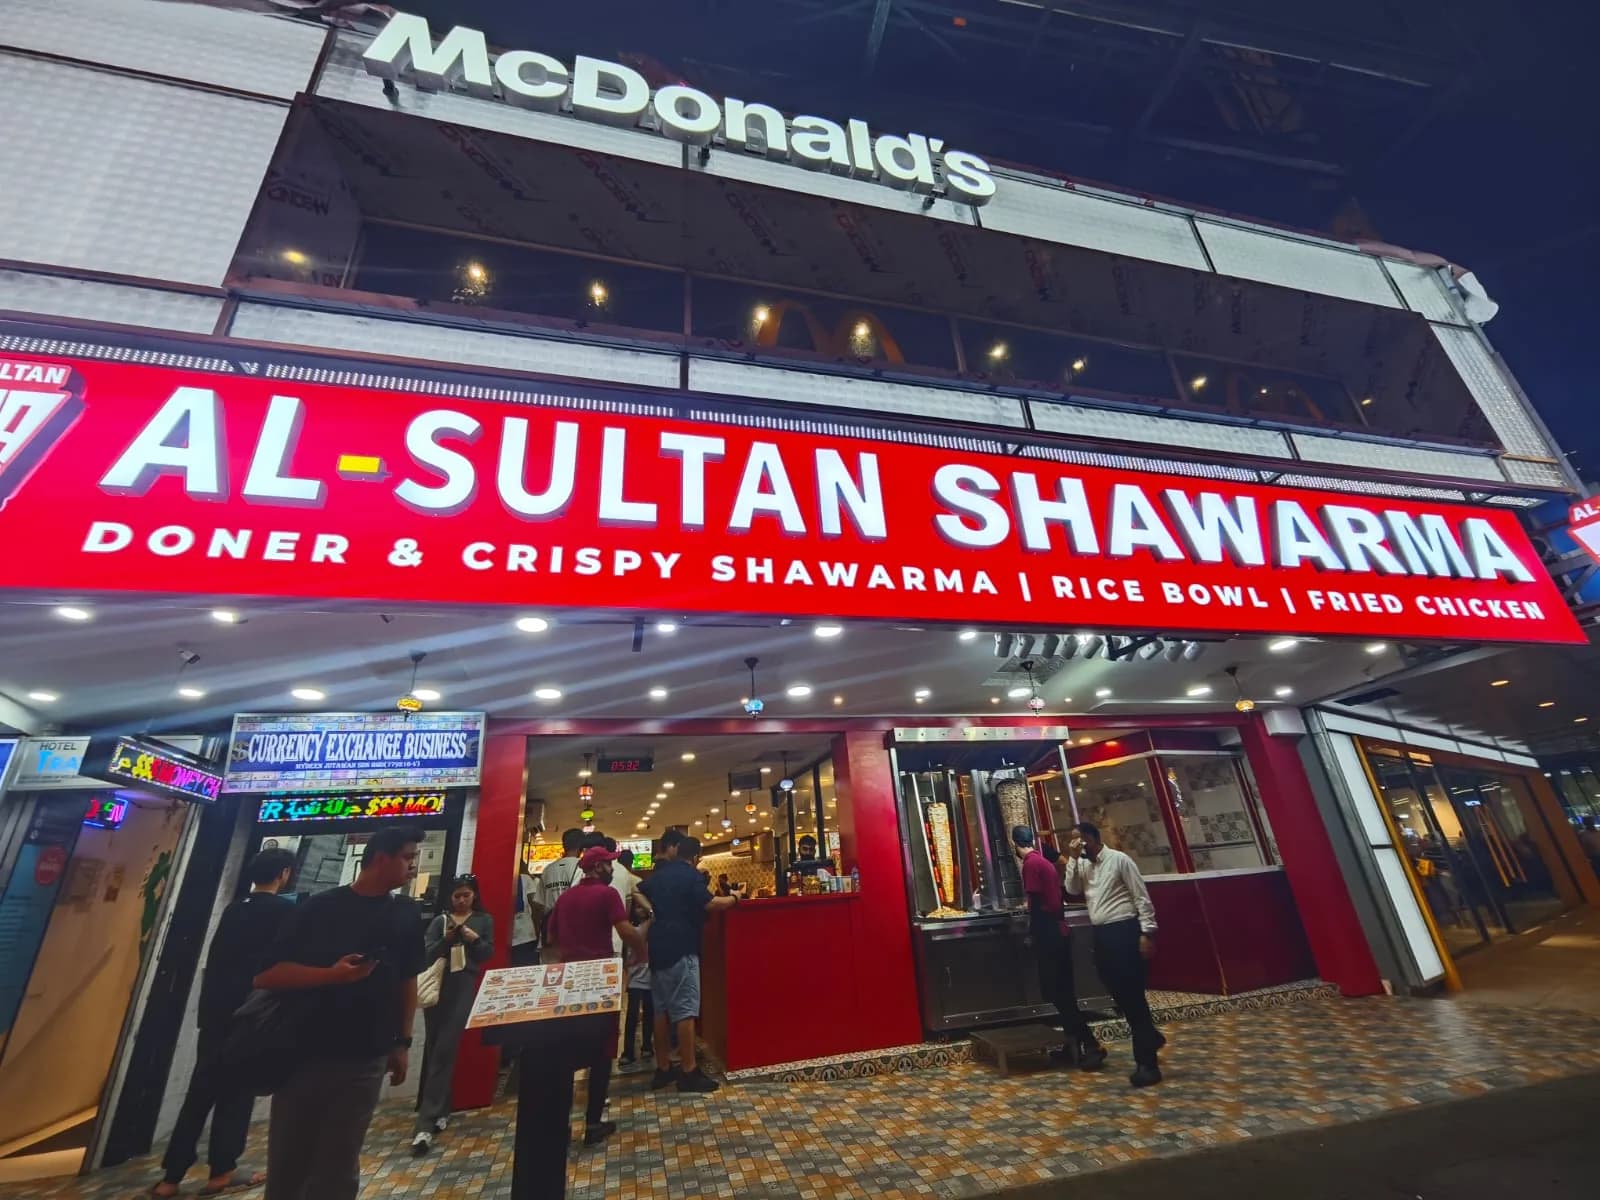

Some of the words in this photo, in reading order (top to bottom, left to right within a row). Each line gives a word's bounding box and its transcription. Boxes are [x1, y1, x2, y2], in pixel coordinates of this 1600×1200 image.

[363, 11, 997, 204] McDonald's
[0, 362, 67, 384] LTAN
[99, 386, 890, 541] AL-SULTAN
[932, 463, 1536, 583] SHAWARMA
[82, 521, 349, 564] DONER
[388, 538, 424, 568] &
[462, 542, 682, 579] CRISPY
[711, 556, 998, 595] SHAWARMA
[1052, 576, 1145, 602] RICE
[1162, 582, 1269, 609] BOWL
[1307, 590, 1404, 614] FRIED
[1416, 595, 1546, 621] CHICKEN
[39, 742, 77, 751] HOTEL
[248, 731, 326, 764] CURRENCY
[327, 733, 402, 762] EXCHANGE
[403, 731, 468, 761] BUSINESS
